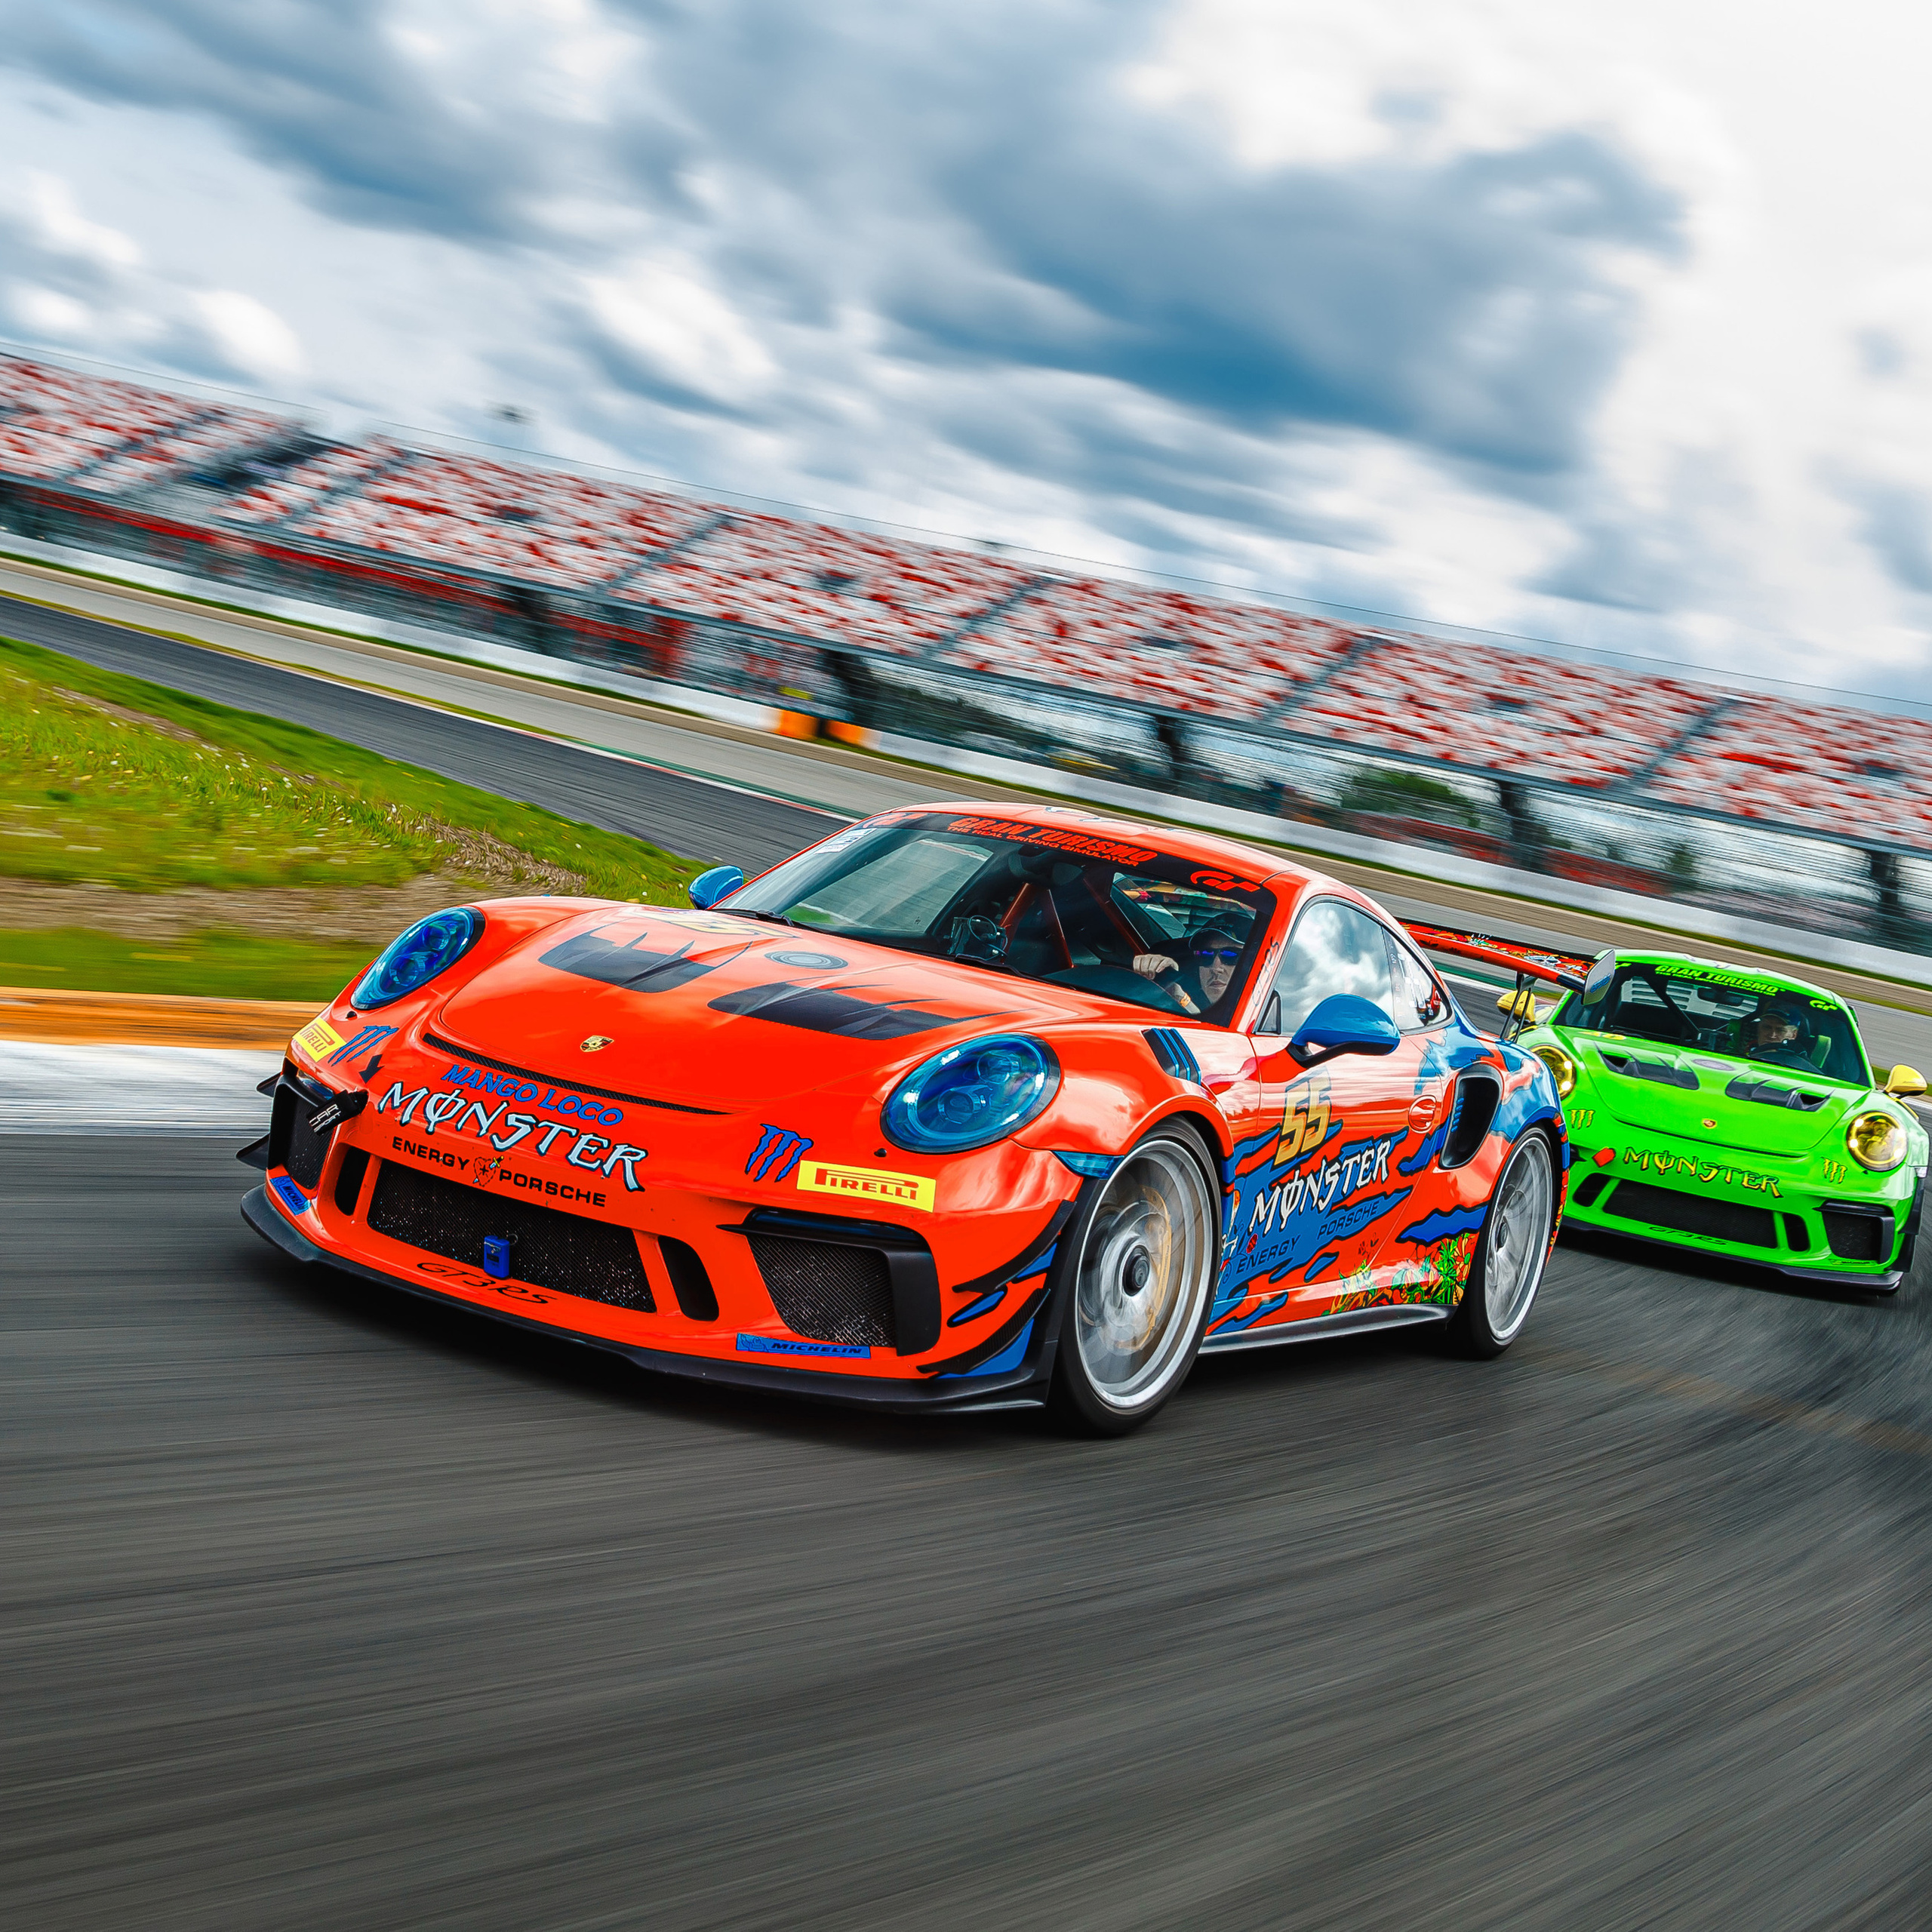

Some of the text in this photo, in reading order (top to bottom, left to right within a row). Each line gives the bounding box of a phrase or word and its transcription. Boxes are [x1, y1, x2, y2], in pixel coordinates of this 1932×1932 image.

[950, 817, 1158, 862] GRAN TURISMO
[972, 829, 1003, 838] REAL
[1006, 835, 1060, 848] DRIVING
[1060, 844, 1139, 866] SIMULATOR
[1654, 965, 1780, 993] GRAN TURISMO
[300, 1023, 335, 1053] PIRELLI
[309, 1103, 339, 1127] CAR
[441, 1065, 623, 1126] MANGO LOCO
[377, 1081, 648, 1192] MONSTER
[1272, 1065, 1333, 1168] 55
[392, 1137, 607, 1208] ENERGY PORSCHE
[815, 1168, 919, 1200] PIRELLI
[1247, 1139, 1391, 1236] MONSTER
[1623, 1146, 1784, 1198] MONSTER
[1317, 1200, 1380, 1239] PORSCHE
[1236, 1235, 1302, 1275] ENERGY
[771, 1342, 863, 1354] MICHELIN
